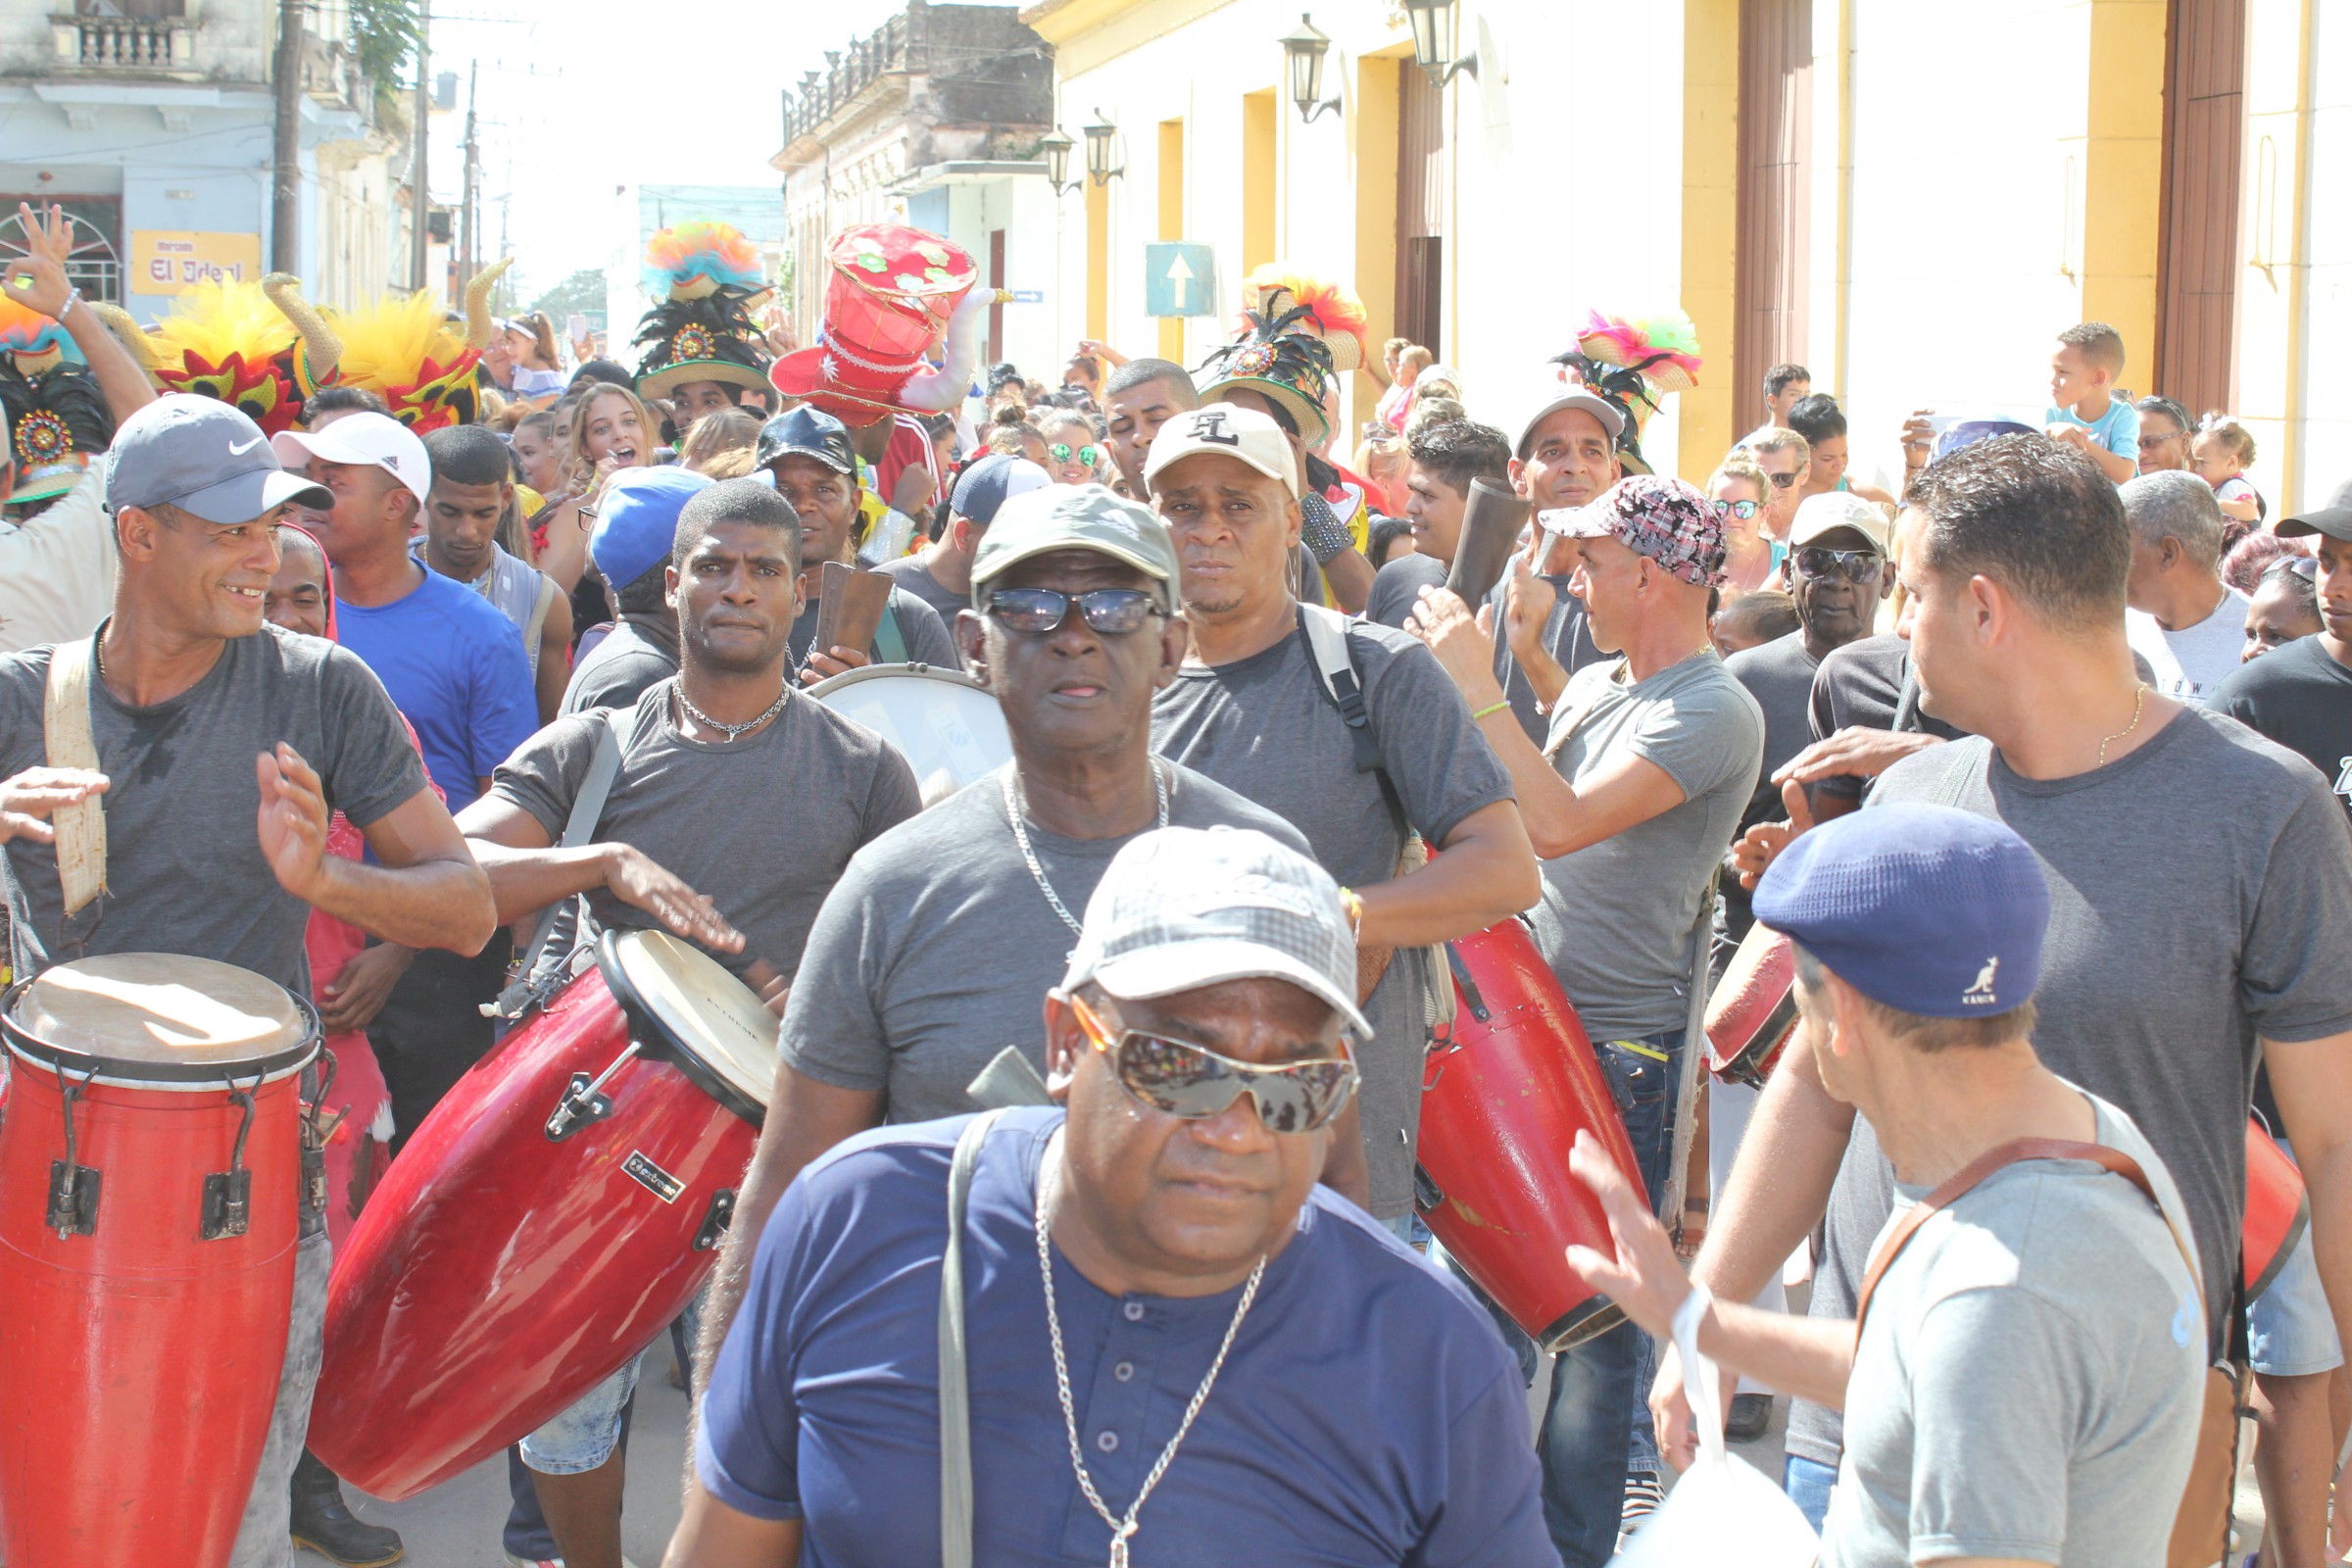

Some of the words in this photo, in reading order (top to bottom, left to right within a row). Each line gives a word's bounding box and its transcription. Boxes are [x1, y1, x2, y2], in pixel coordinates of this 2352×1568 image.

[150, 259, 173, 282] El
[182, 260, 242, 283] Idel
[2160, 678, 2217, 695] TOW
[707, 997, 760, 1042] EXTREME
[639, 1167, 677, 1196] extreme
